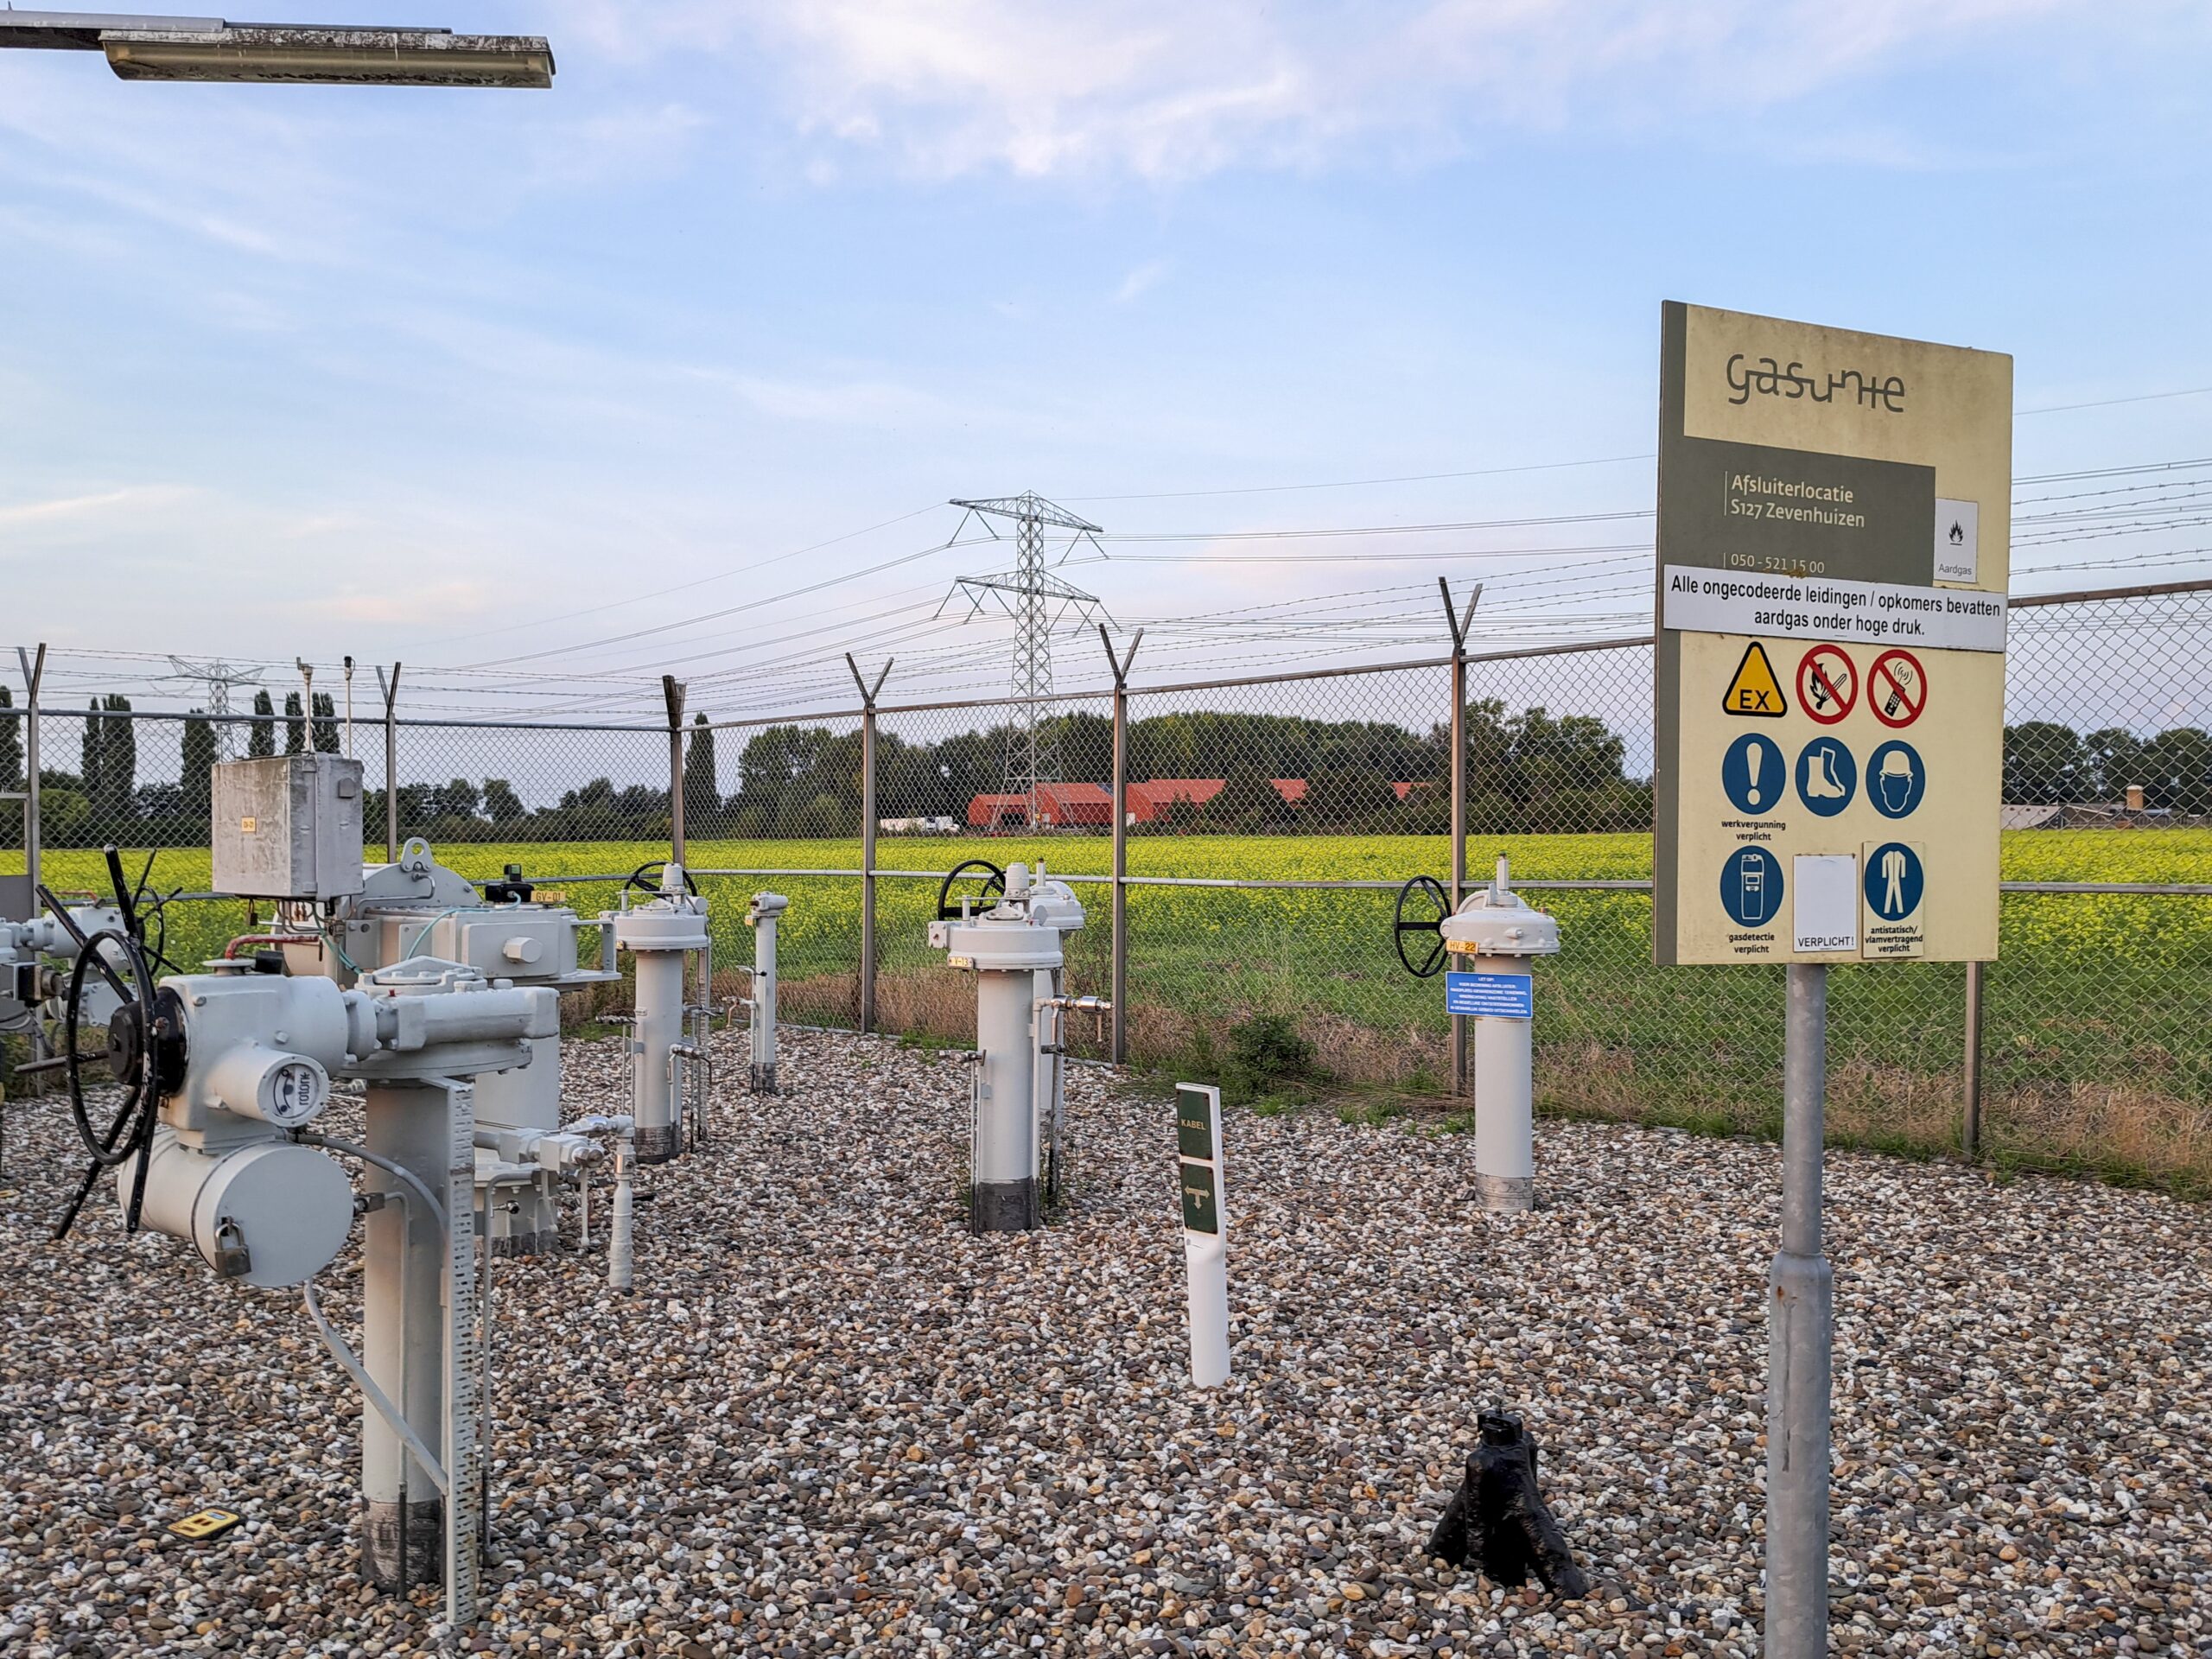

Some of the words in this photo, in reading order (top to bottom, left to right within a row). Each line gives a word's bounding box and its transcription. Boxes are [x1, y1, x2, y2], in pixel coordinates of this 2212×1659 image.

[1726, 353, 1904, 412] gasunie
[1731, 474, 1853, 503] Afsluiterlocatie
[1731, 499, 1763, 519] S127
[1765, 502, 1865, 528] Zevenhuizen
[1731, 553, 1755, 567] 050
[1765, 556, 1787, 570] 521
[1791, 559, 1806, 571] 15
[1809, 561, 1825, 574] 00
[1938, 563, 1973, 576] Aardgas
[1671, 575, 1699, 594] Alle
[1703, 581, 1802, 601] ongecodeerde
[1806, 586, 1866, 609] leidingen
[1878, 593, 1943, 612] opkomers
[1947, 596, 2000, 616] bevatten
[1754, 609, 1808, 631] aardgas
[1813, 613, 1853, 629] onder
[1856, 614, 1889, 636] hoge
[1892, 618, 1925, 635] druk.
[1738, 689, 1770, 711] EX
[1721, 819, 1786, 831] werkvergunning
[1736, 831, 1771, 842] verplicht
[536, 892, 561, 901] GV-01
[1870, 925, 1918, 935] antistatisch/
[1728, 932, 1775, 944] gasdetectie
[1797, 936, 1854, 947] VERPLICHT!
[1865, 934, 1923, 944] vlamvertragend
[1450, 941, 1476, 952] HV-22
[1734, 944, 1770, 955] verplicht
[1878, 944, 1910, 954] verplicht
[298, 1071, 310, 1106] rotork
[1180, 1118, 1207, 1131] KABEL
